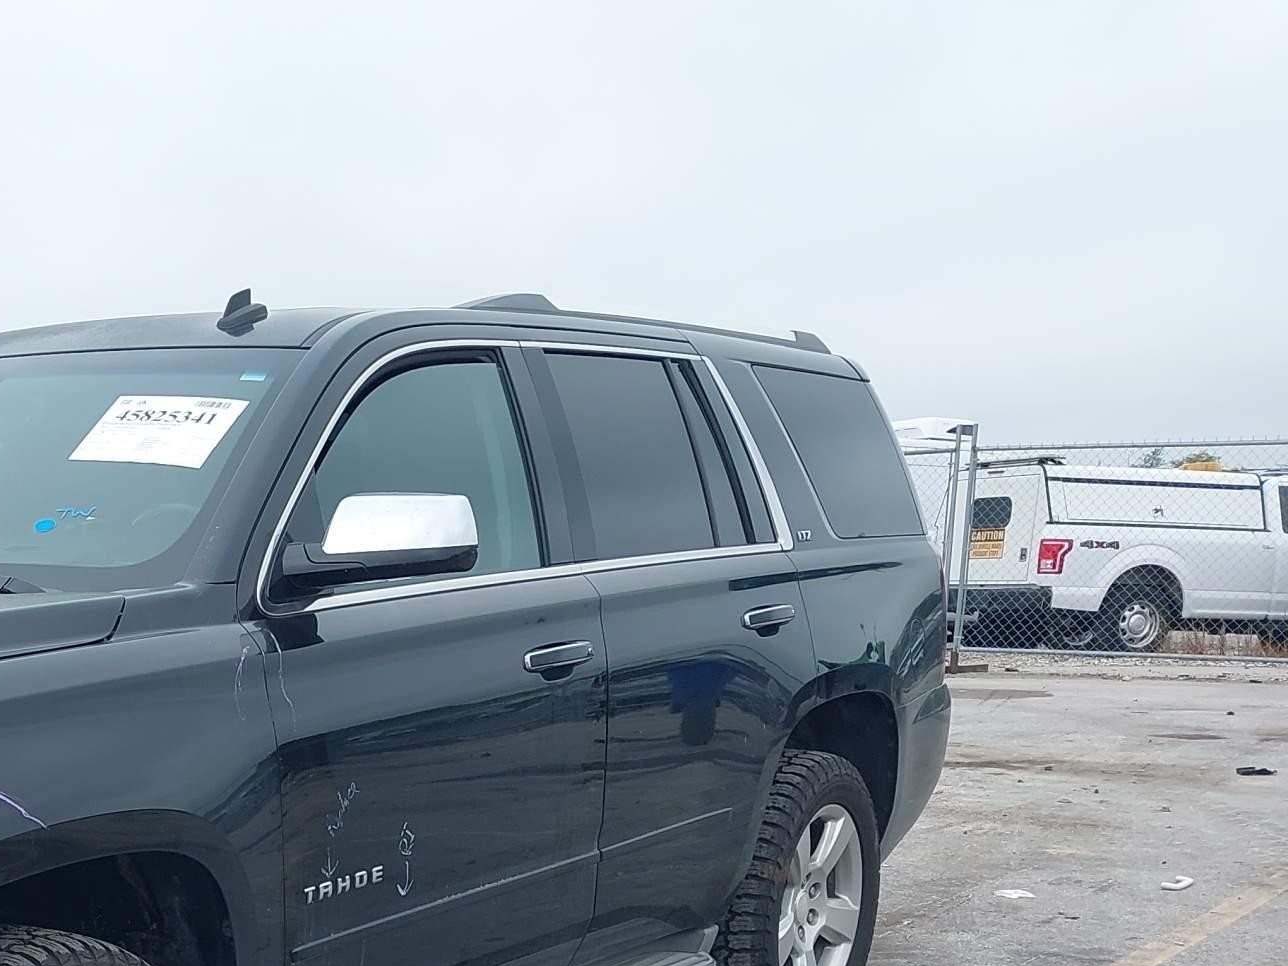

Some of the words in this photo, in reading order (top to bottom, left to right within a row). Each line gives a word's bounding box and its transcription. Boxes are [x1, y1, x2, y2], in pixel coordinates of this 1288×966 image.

[115, 409, 219, 425] 45825341
[971, 530, 1004, 541] CAUTION
[303, 864, 385, 905] TAHOE
